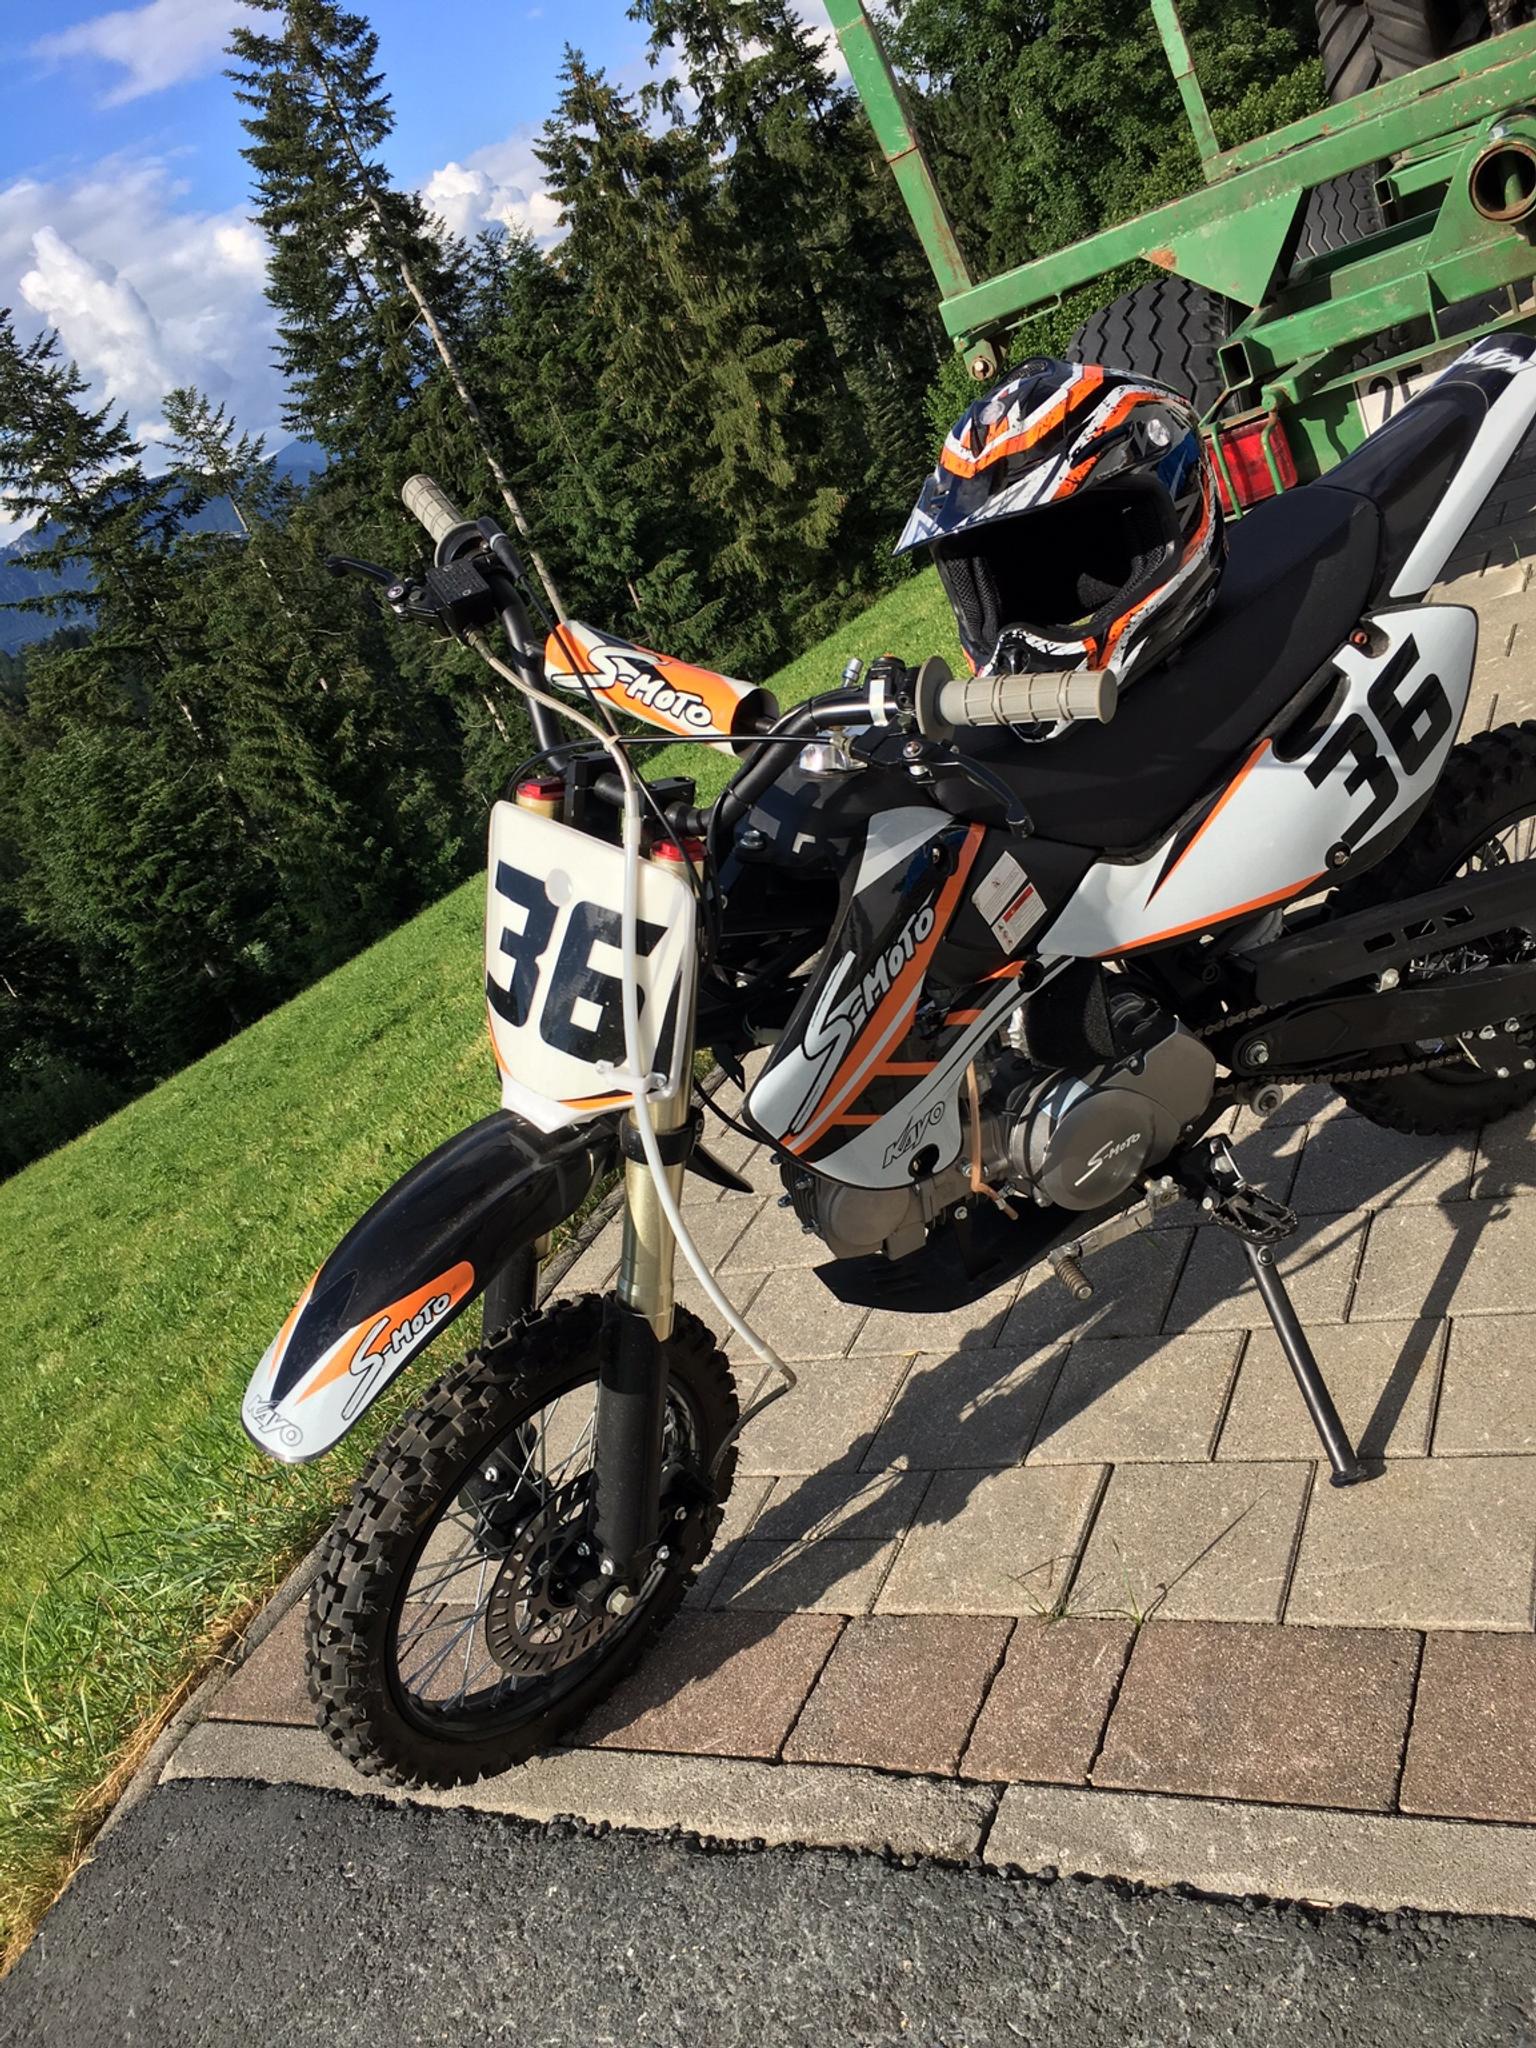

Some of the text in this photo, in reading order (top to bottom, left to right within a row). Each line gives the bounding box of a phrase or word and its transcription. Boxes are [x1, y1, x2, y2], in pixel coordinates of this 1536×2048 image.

[551, 645, 713, 728] S-MOTO
[1304, 632, 1453, 851] 36
[486, 859, 669, 1068] 36
[788, 889, 936, 1134] S-MOTO
[1074, 1132, 1142, 1187] S-MOTO
[342, 1294, 452, 1420] S-MOTO
